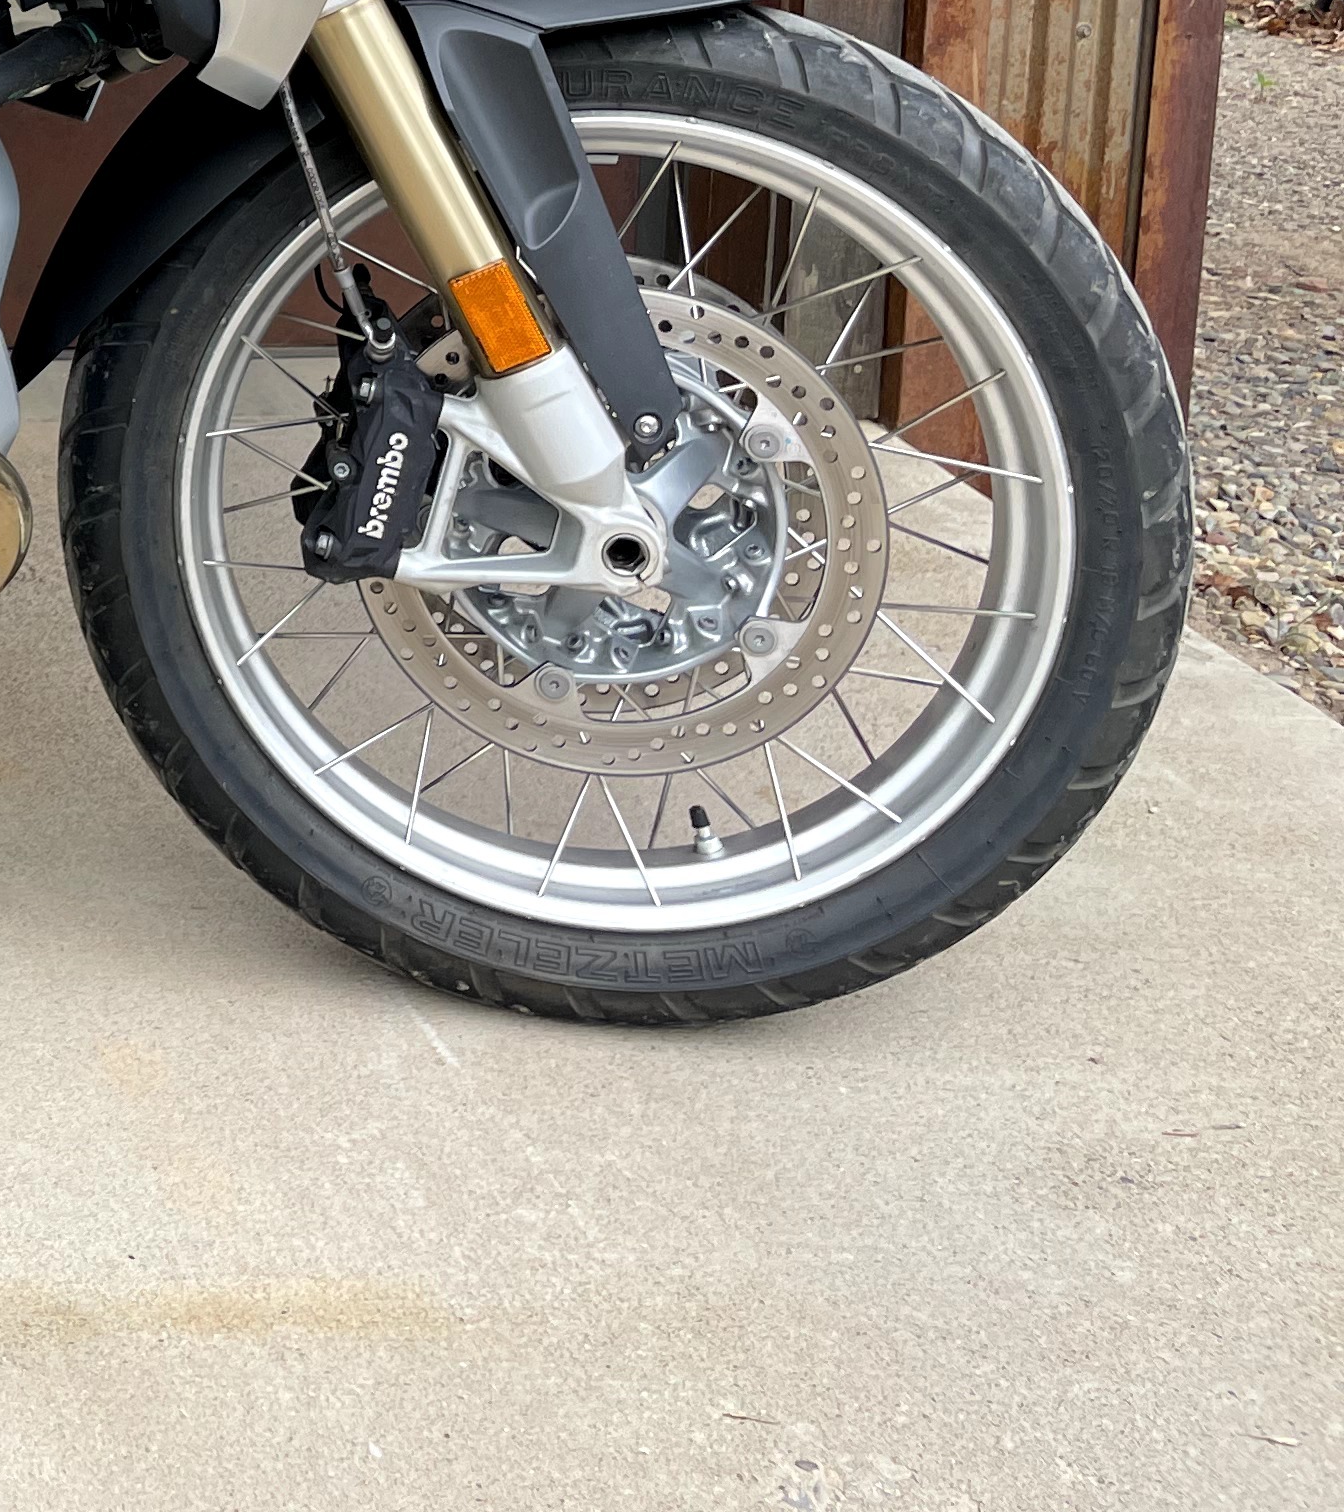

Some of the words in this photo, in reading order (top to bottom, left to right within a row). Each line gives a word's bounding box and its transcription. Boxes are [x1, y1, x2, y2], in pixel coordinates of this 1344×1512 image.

[562, 67, 807, 130] URANCE
[358, 431, 409, 539] brembo
[411, 895, 765, 984] METZELER
